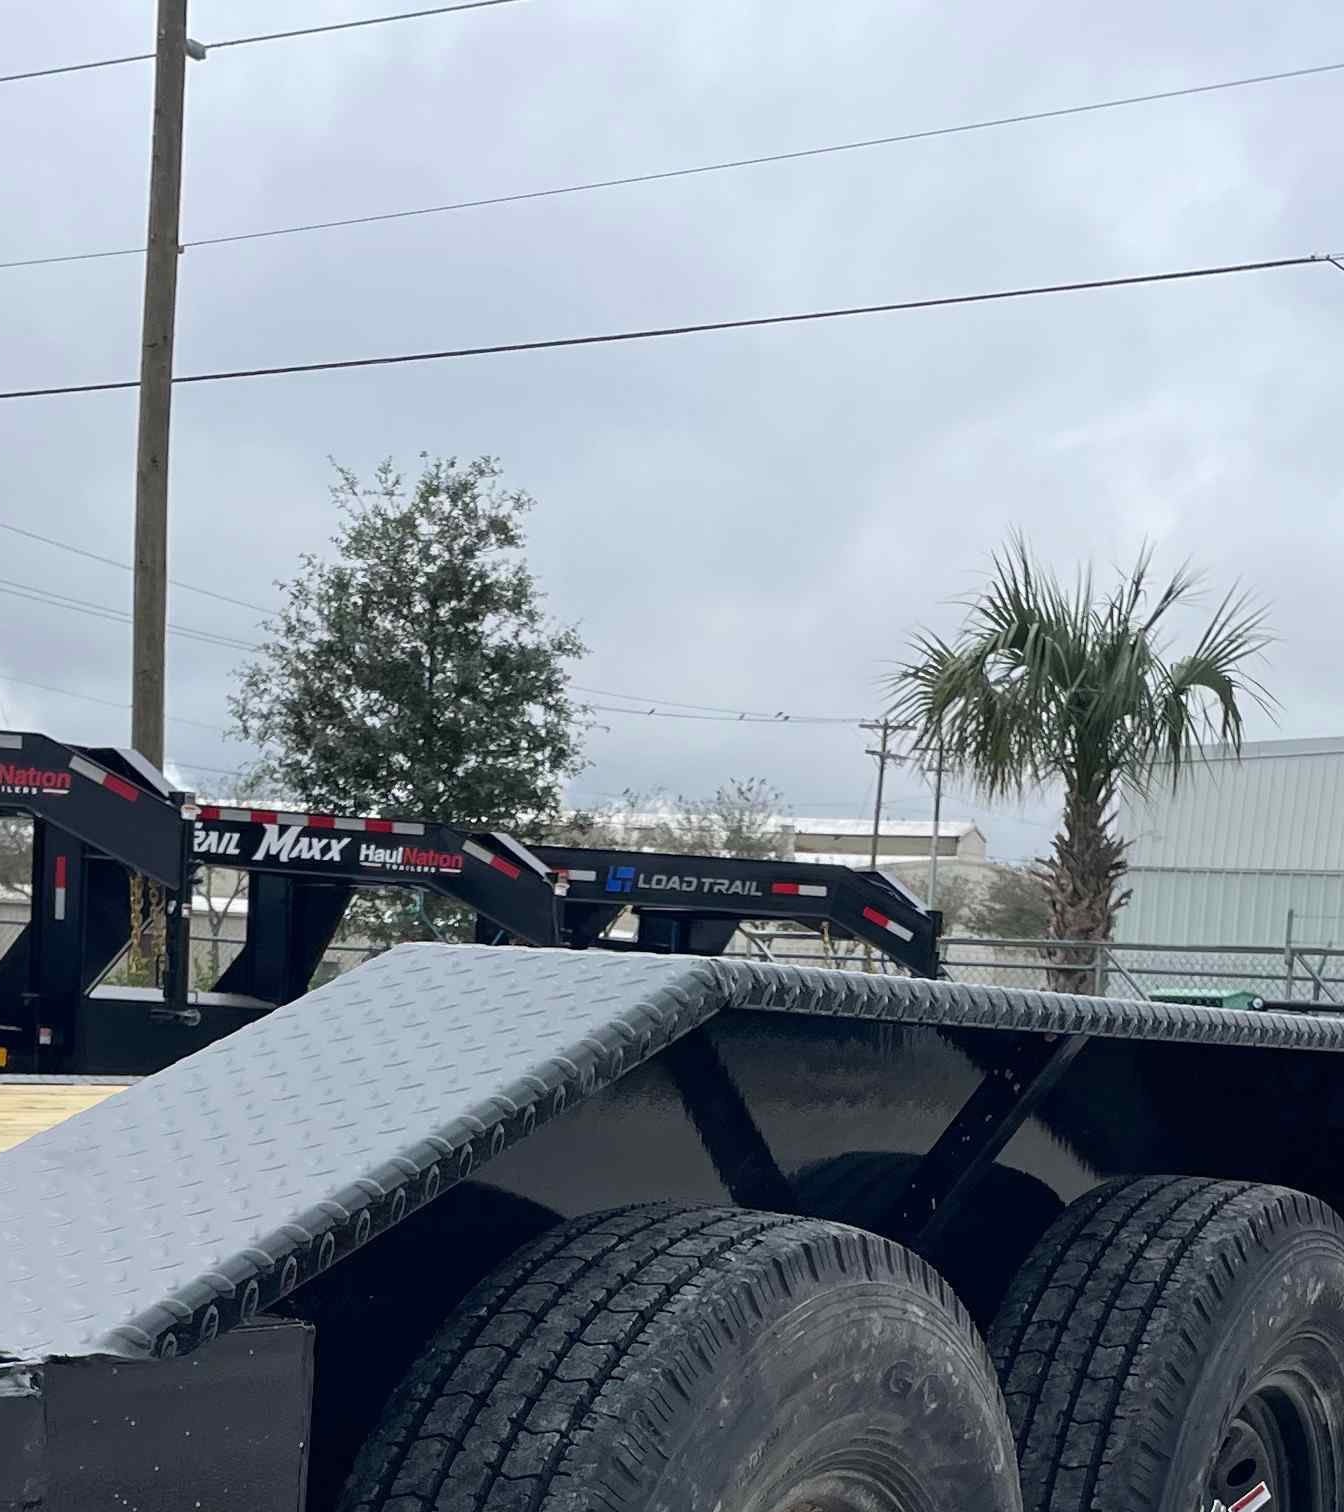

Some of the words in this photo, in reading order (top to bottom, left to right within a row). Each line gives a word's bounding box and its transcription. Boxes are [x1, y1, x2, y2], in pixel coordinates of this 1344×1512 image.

[193, 822, 241, 855] RAIL
[251, 824, 352, 862] MAXX
[359, 843, 464, 868] HaulNation
